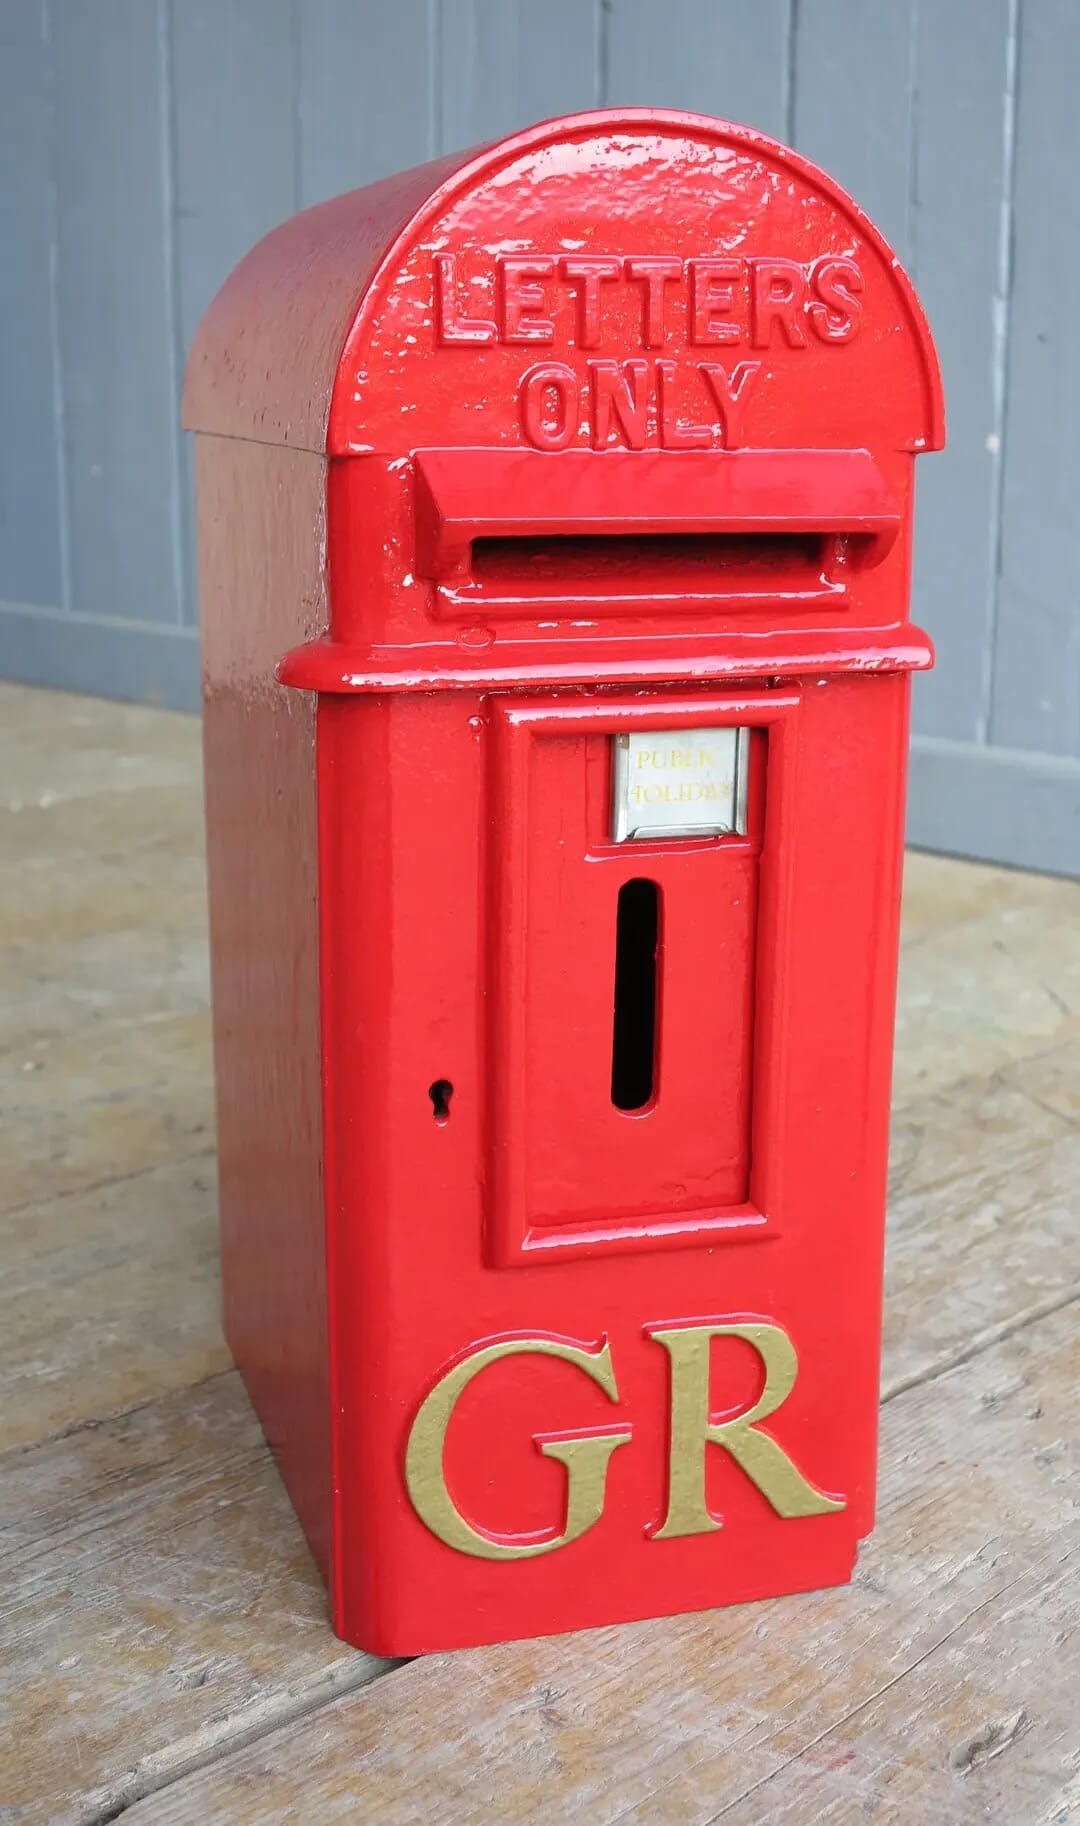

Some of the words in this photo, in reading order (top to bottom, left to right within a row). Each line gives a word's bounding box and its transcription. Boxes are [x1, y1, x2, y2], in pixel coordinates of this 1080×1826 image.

[433, 254, 866, 350] LETTERS
[518, 358, 761, 451] ONLY
[404, 1312, 847, 1560] GR
